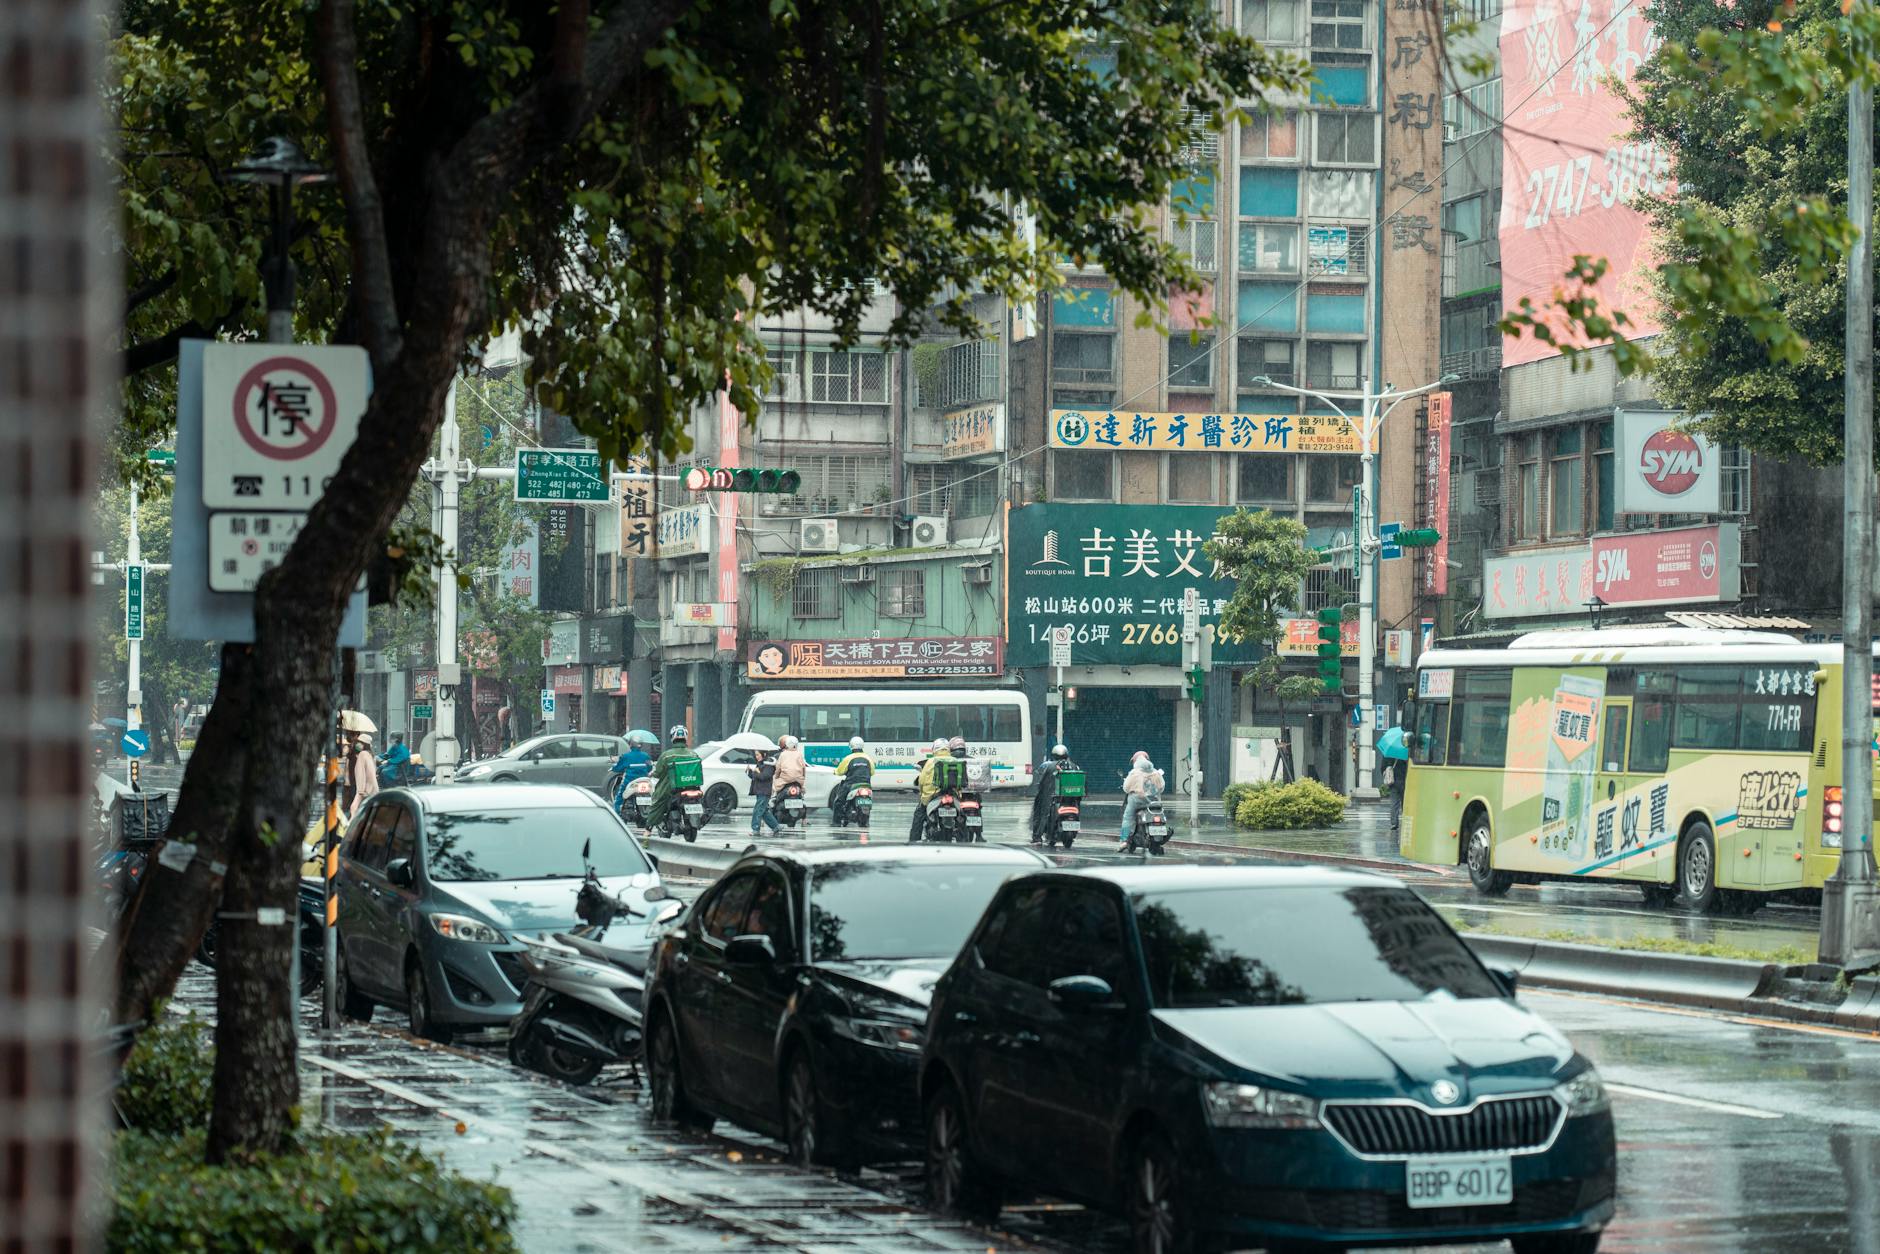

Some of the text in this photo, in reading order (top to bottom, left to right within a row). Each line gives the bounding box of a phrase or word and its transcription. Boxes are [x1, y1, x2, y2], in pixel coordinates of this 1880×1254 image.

[257, 381, 313, 437] 停
[1094, 412, 1294, 449] 達新牙醫診所
[1298, 416, 1353, 427] 齒列矯正
[1298, 426, 1354, 436] 植牙
[528, 454, 602, 467] 忠孝東路五段
[1641, 449, 1702, 482] SYM
[575, 490, 591, 499] 473
[622, 487, 652, 554] 植牙
[1425, 435, 1437, 589] 天橋下豆之家
[558, 509, 567, 539] SUSH
[511, 549, 532, 597] 肉麵
[1596, 548, 1631, 592] SYM
[1024, 597, 1134, 615] 松山站600米
[1027, 623, 1111, 645] 1426坪
[1122, 623, 1244, 646] 2766-9
[1289, 644, 1319, 652] 純卡拉O
[907, 665, 993, 674] 02-27253221
[963, 657, 985, 665] Bridge
[1755, 669, 1816, 697] 大都會客運
[1767, 704, 1801, 732] 771-FR
[875, 746, 915, 756] 松德院區
[966, 746, 997, 756] 永春站
[1594, 783, 1669, 860] 驅蚊寶
[1737, 816, 1777, 829] SPEED
